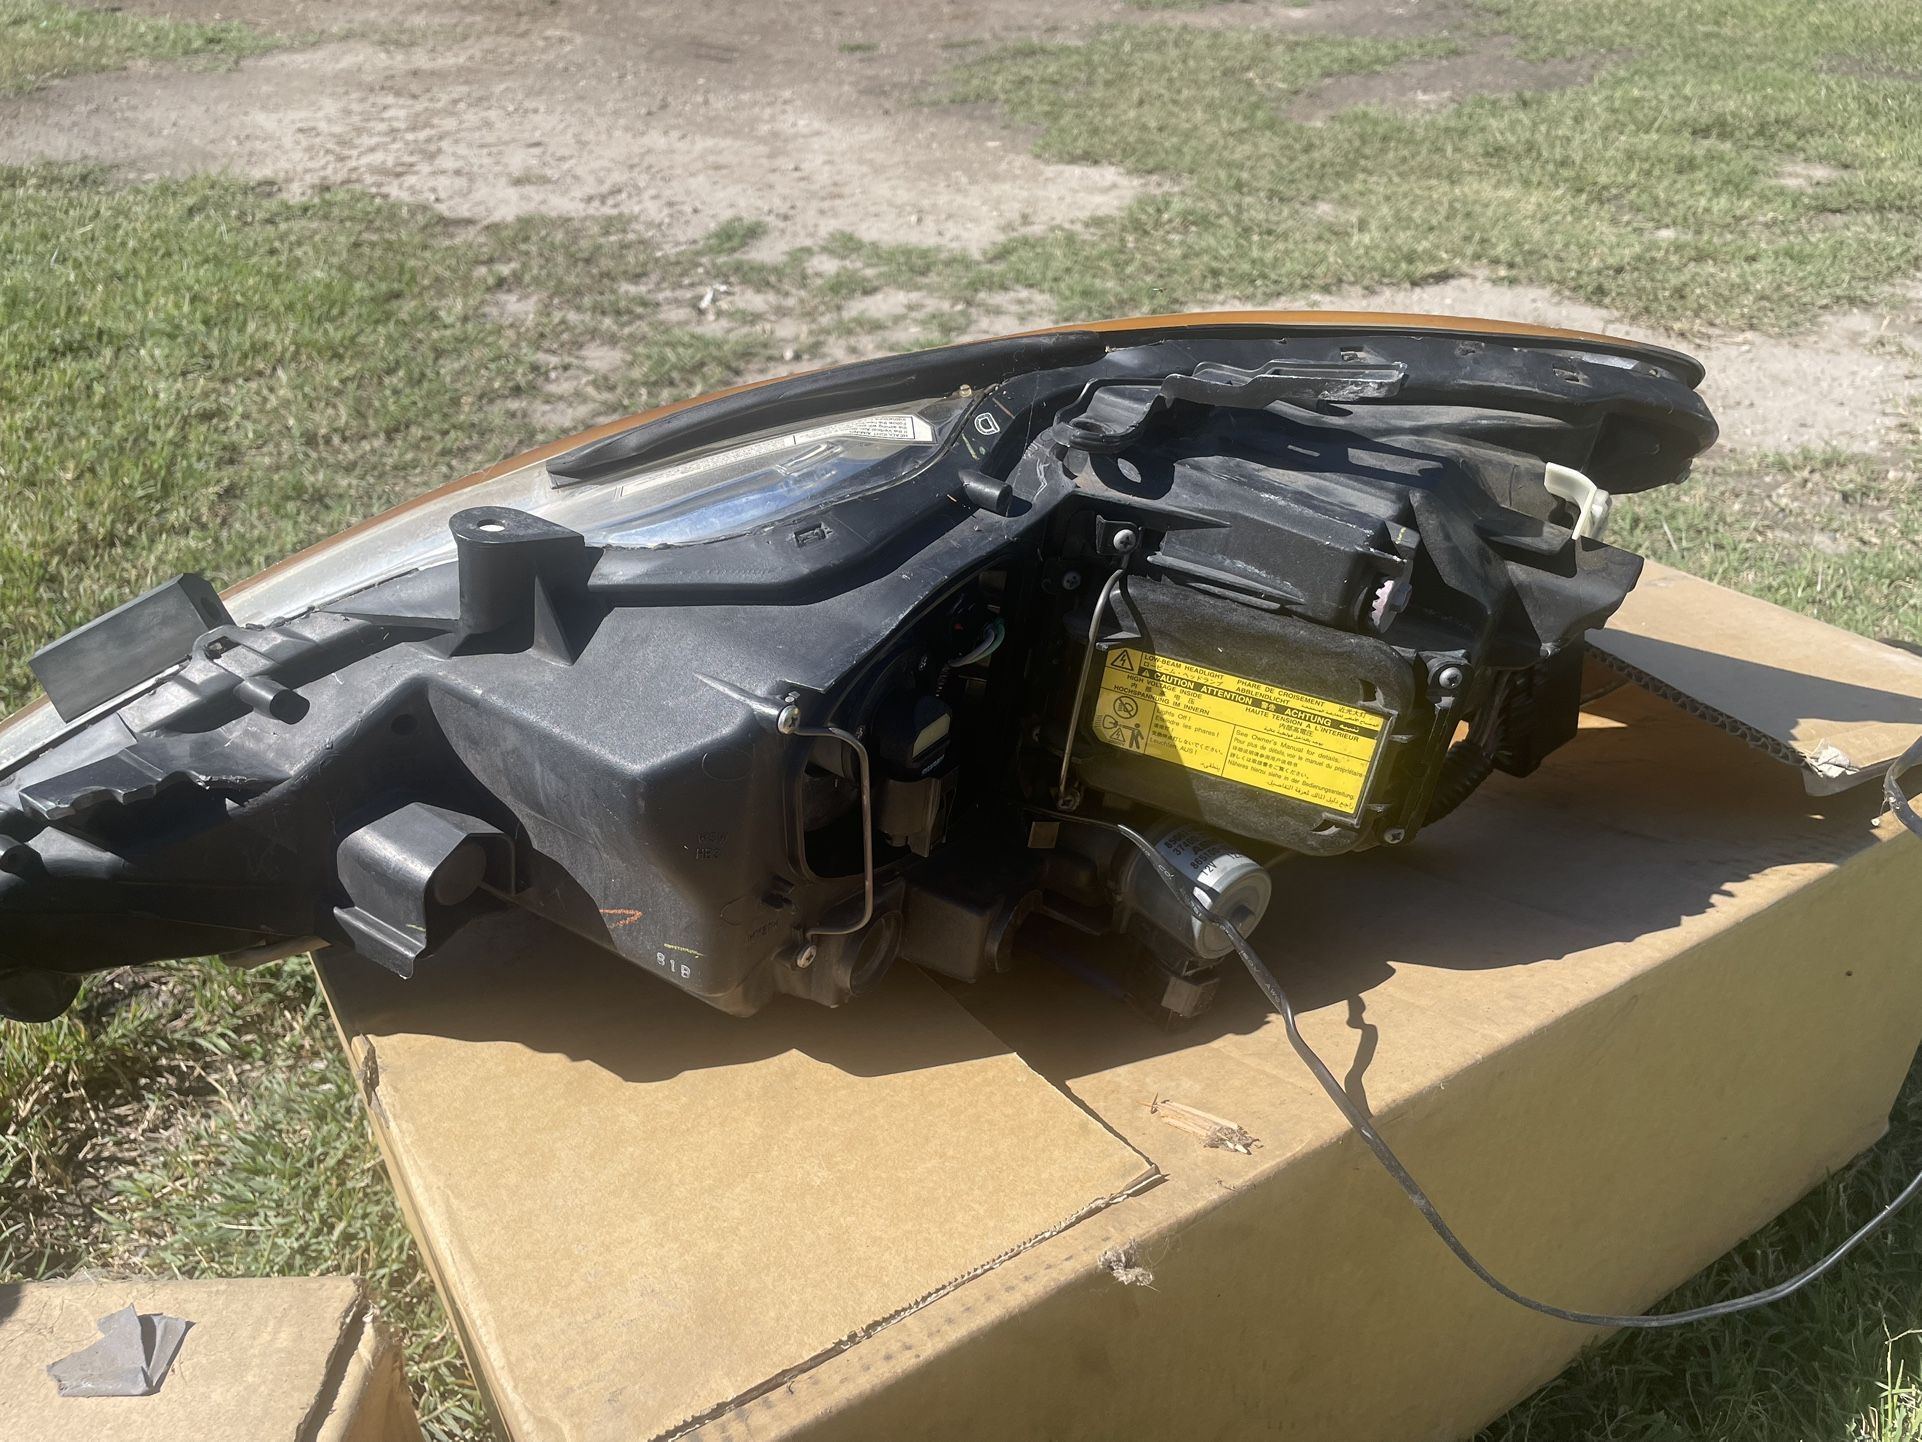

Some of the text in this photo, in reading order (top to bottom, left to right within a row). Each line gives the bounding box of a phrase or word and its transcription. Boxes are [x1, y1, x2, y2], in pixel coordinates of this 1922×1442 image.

[1144, 654, 1224, 680] LOW-BEAM HEADLIGHT
[1127, 674, 1202, 699] HIGH VOLTAGE INSIDE
[1154, 672, 1253, 705] CAUTION ATTENTION
[1235, 686, 1290, 706] ABBLENDLICHT
[1236, 679, 1324, 708] PHARE DE CROISEMENT
[1113, 684, 1210, 716] HOCHSPANNUNG IM INNERN
[1245, 706, 1269, 718] HAUTE
[1272, 713, 1303, 727] TENSION
[1284, 708, 1332, 727] ACHTUNG
[1233, 737, 1245, 745] Pour
[1305, 756, 1323, 766] manuel
[1236, 729, 1248, 737] See
[1251, 734, 1277, 745] Owner's
[1280, 742, 1303, 752] Manual
[1200, 861, 1217, 876] 12V
